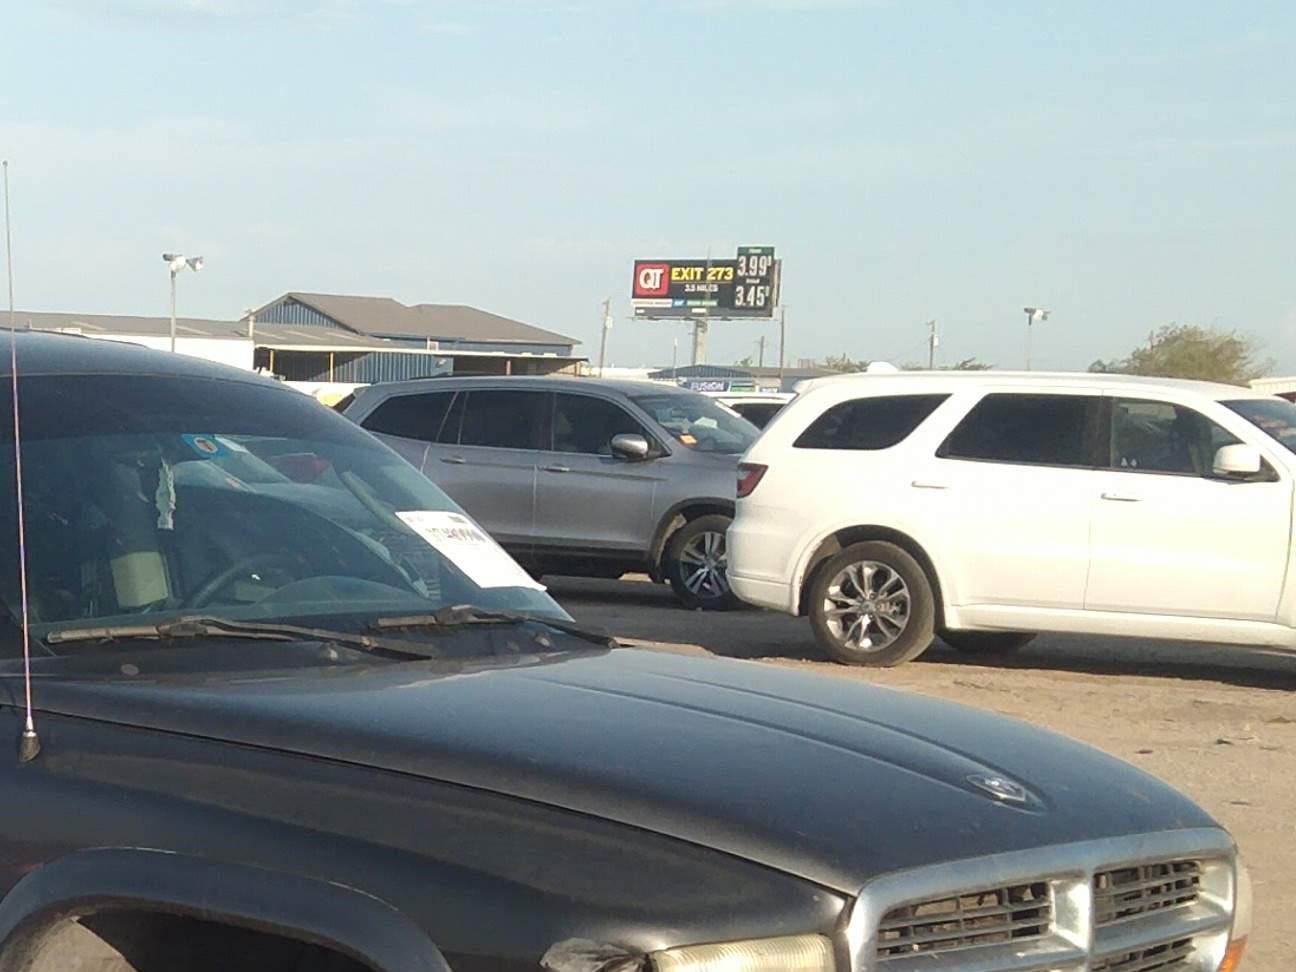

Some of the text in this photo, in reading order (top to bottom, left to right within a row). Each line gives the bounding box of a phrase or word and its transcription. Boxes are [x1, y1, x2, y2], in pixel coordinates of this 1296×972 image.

[639, 268, 664, 290] QT
[671, 267, 704, 281] EXIT
[706, 267, 734, 281] 273
[690, 381, 724, 392] FUSION
